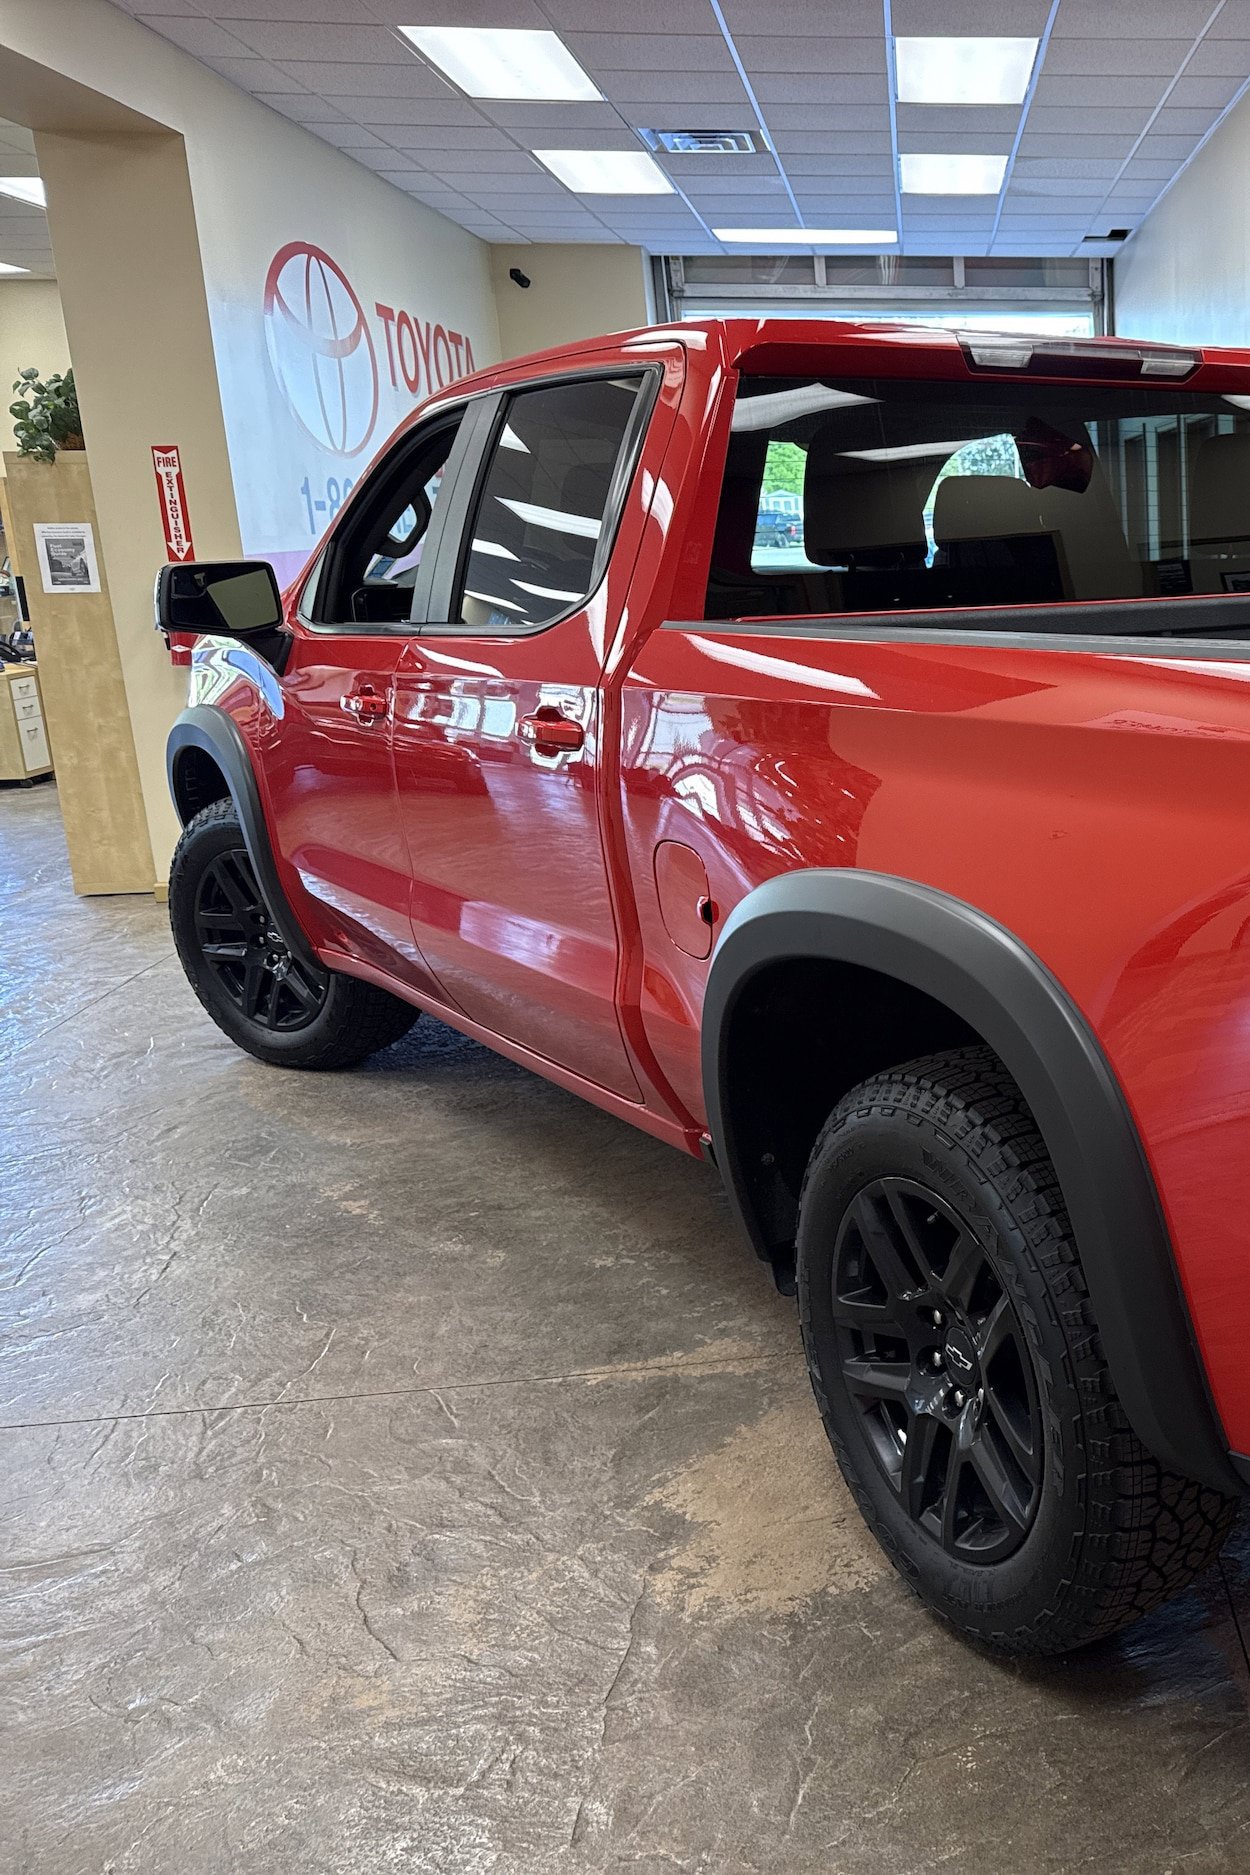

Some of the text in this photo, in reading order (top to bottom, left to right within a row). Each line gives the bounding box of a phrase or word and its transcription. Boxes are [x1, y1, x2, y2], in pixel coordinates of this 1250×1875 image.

[375, 302, 475, 395] TOYOTA
[156, 456, 178, 468] FIRE
[165, 471, 185, 554] EXTINGUISHER
